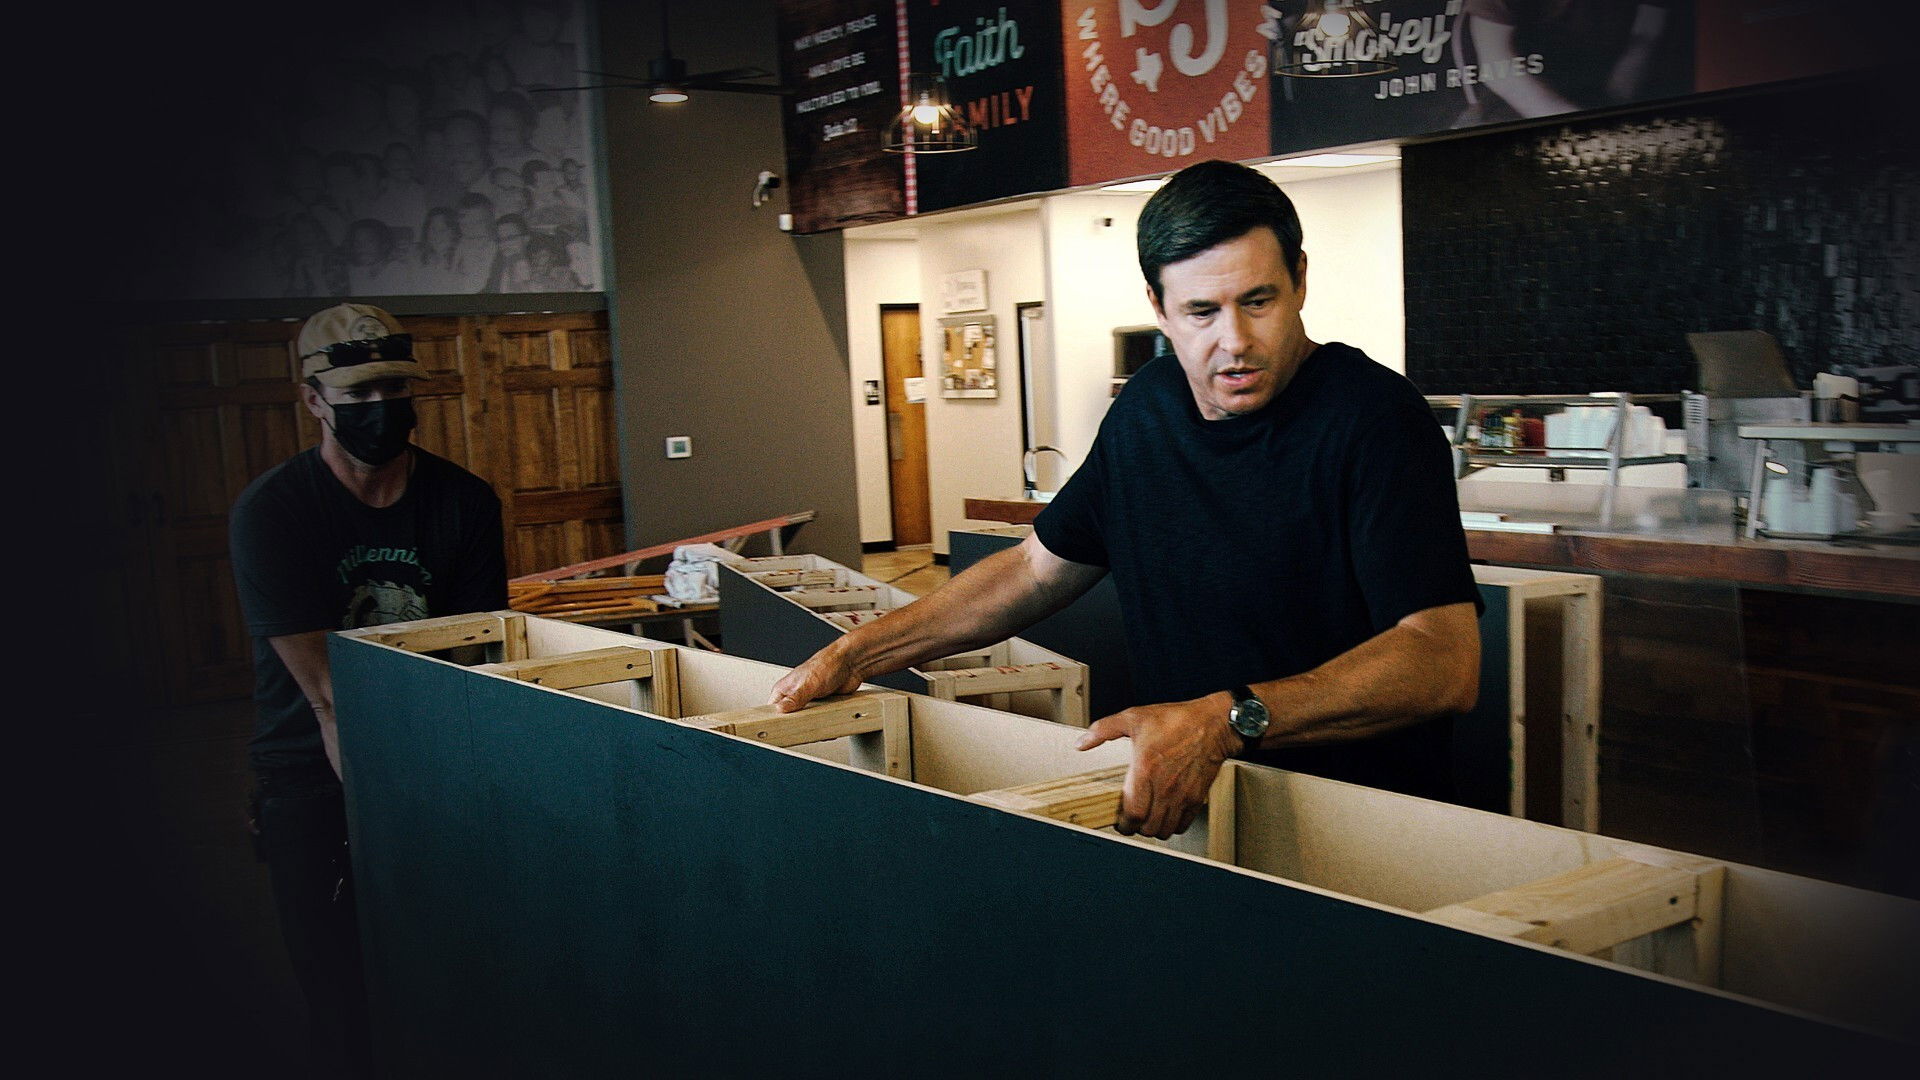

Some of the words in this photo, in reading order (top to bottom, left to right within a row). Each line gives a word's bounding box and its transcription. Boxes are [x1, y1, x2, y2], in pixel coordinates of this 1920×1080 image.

[934, 6, 1025, 82] Faith
[1076, 6, 1131, 131] WHERE
[1129, 118, 1196, 158] GOOD
[1197, 49, 1268, 143] VIBES
[1374, 72, 1437, 100] JOHN
[1446, 53, 1545, 88] REAVES
[938, 85, 1034, 137] AMILY
